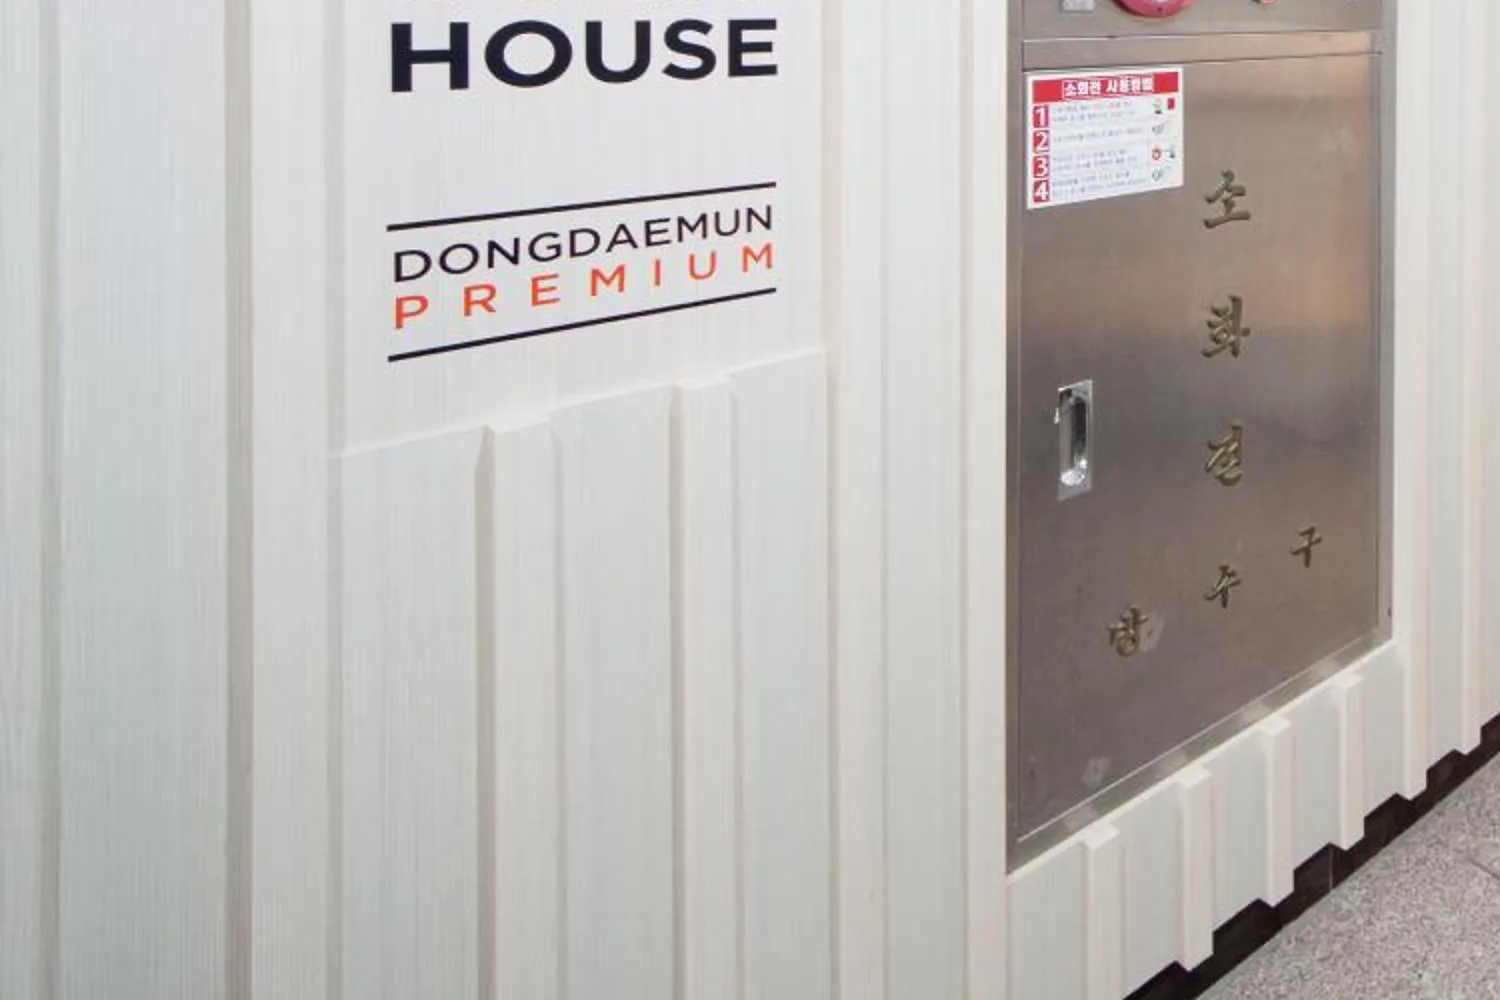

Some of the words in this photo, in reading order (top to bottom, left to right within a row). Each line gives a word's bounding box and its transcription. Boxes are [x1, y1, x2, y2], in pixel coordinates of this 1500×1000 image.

[391, 18, 778, 92] HOUSE
[1034, 107, 1046, 126] 1
[1034, 132, 1049, 151] 2
[1034, 157, 1048, 177] 3
[1034, 182, 1049, 202] 4
[393, 204, 773, 282] DONGDAEMUN
[394, 242, 774, 330] PREMIUM
